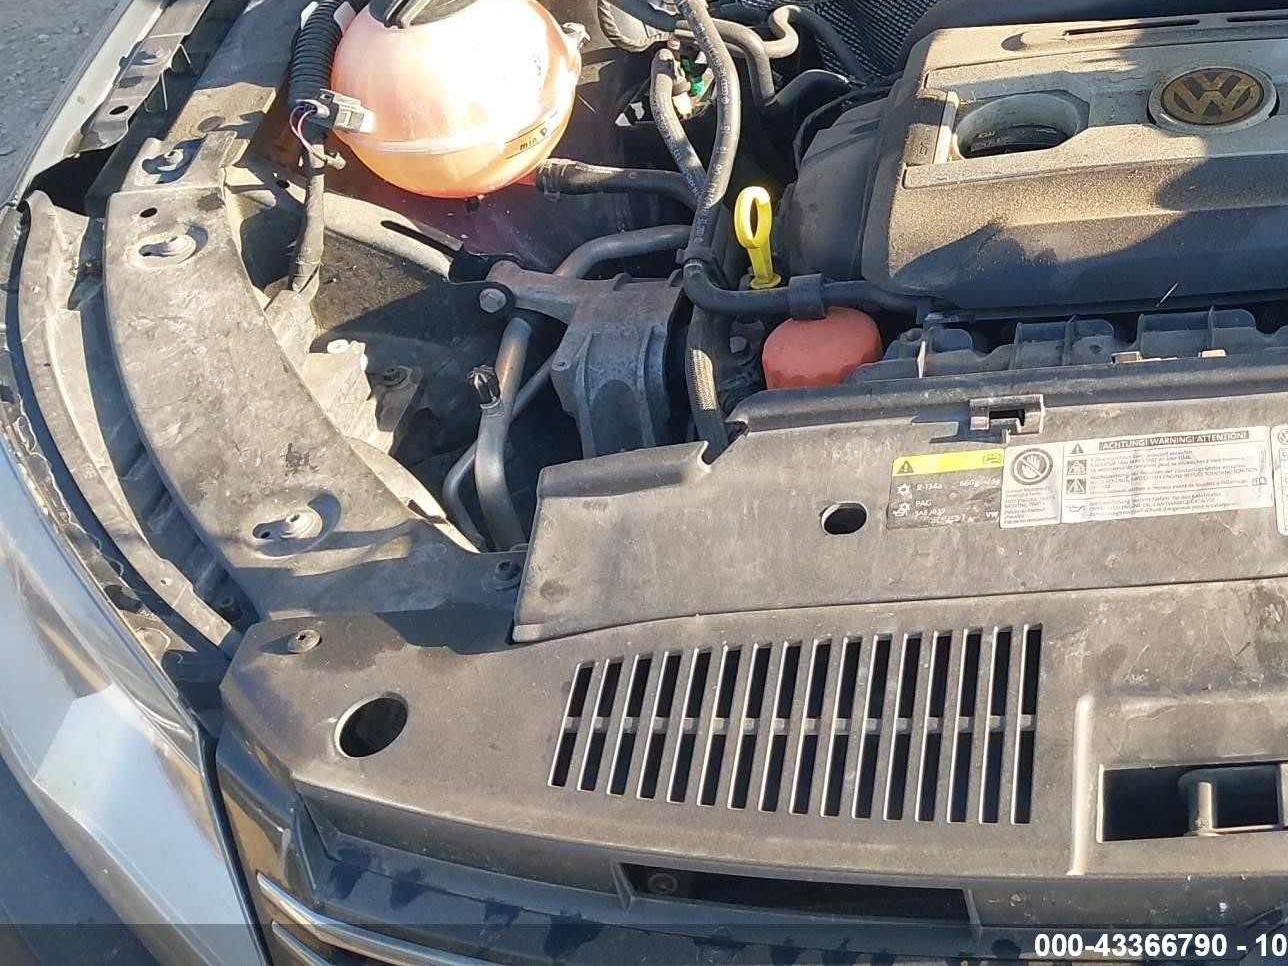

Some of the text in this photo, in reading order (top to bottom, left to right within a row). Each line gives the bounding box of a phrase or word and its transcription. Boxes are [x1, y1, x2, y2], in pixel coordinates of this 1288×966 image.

[519, 137, 538, 151] min
[1102, 432, 1247, 451] ACHTUNG! WARNING! ATTENTION!
